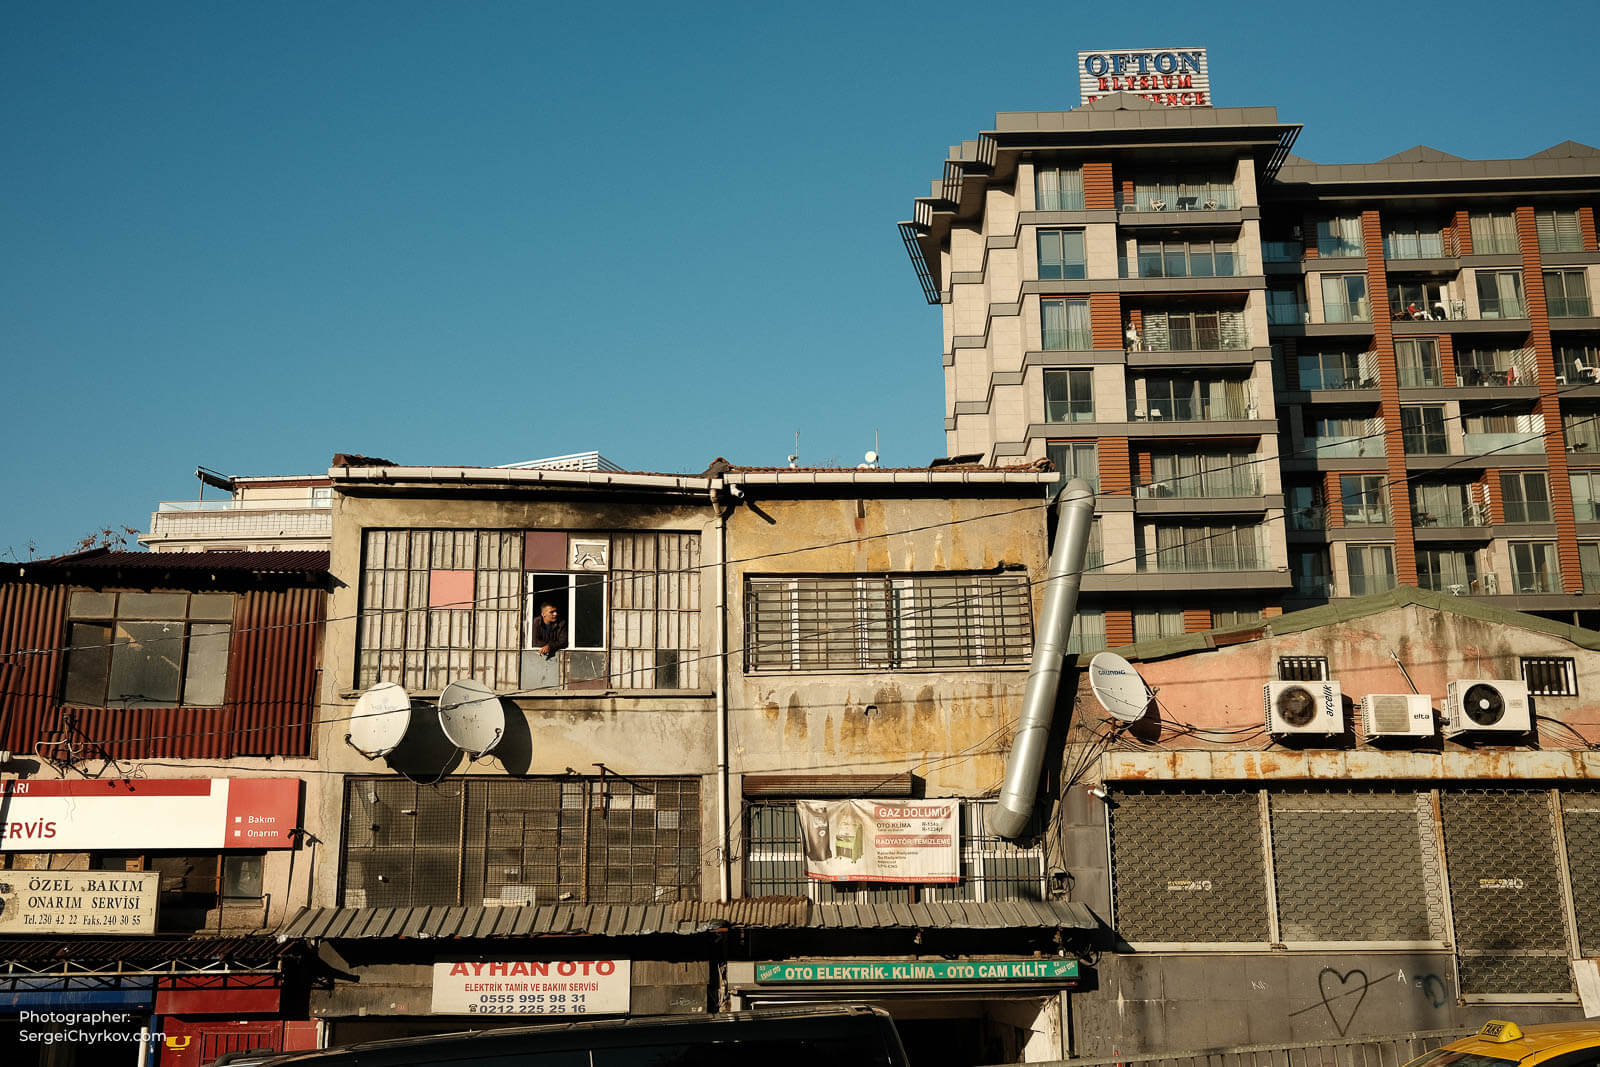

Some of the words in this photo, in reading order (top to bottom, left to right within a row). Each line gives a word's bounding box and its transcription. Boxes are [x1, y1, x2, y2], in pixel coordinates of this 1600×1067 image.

[1085, 52, 1202, 77] OFTON
[1097, 75, 1192, 91] ELYSIUM
[879, 808, 901, 817] GAZ
[903, 808, 947, 817] DOLUMU
[248, 815, 275, 824] Bakım
[247, 829, 279, 838] Onarım
[28, 876, 74, 892] ÖZEL
[87, 880, 144, 892] BAKIM
[28, 896, 82, 909] ONARIM
[91, 895, 140, 910] SERVİSİ
[55, 914, 65, 925] 42
[68, 914, 78, 925] 22
[120, 914, 129, 925] 30
[131, 914, 141, 925] 55
[449, 961, 549, 977] AYHAN
[556, 960, 616, 977] OTO
[785, 967, 813, 980] OTO
[892, 963, 936, 979] KLİMA
[947, 965, 975, 978] OTO
[979, 965, 1008, 977] CAM
[1012, 961, 1047, 977] KİLİT
[464, 982, 503, 992] ELEKTRİK
[505, 982, 528, 992] TAMİR
[530, 983, 541, 992] VE
[542, 983, 567, 992] BAKIM
[569, 981, 599, 992] SERVİSİ
[480, 994, 515, 1003] 0555
[519, 994, 545, 1003] 995
[549, 994, 566, 1003] 98
[571, 994, 586, 1003] 31
[479, 1004, 514, 1013] 0212
[519, 1004, 545, 1013] 225
[549, 1004, 566, 1013] 25
[571, 1004, 586, 1013] 16
